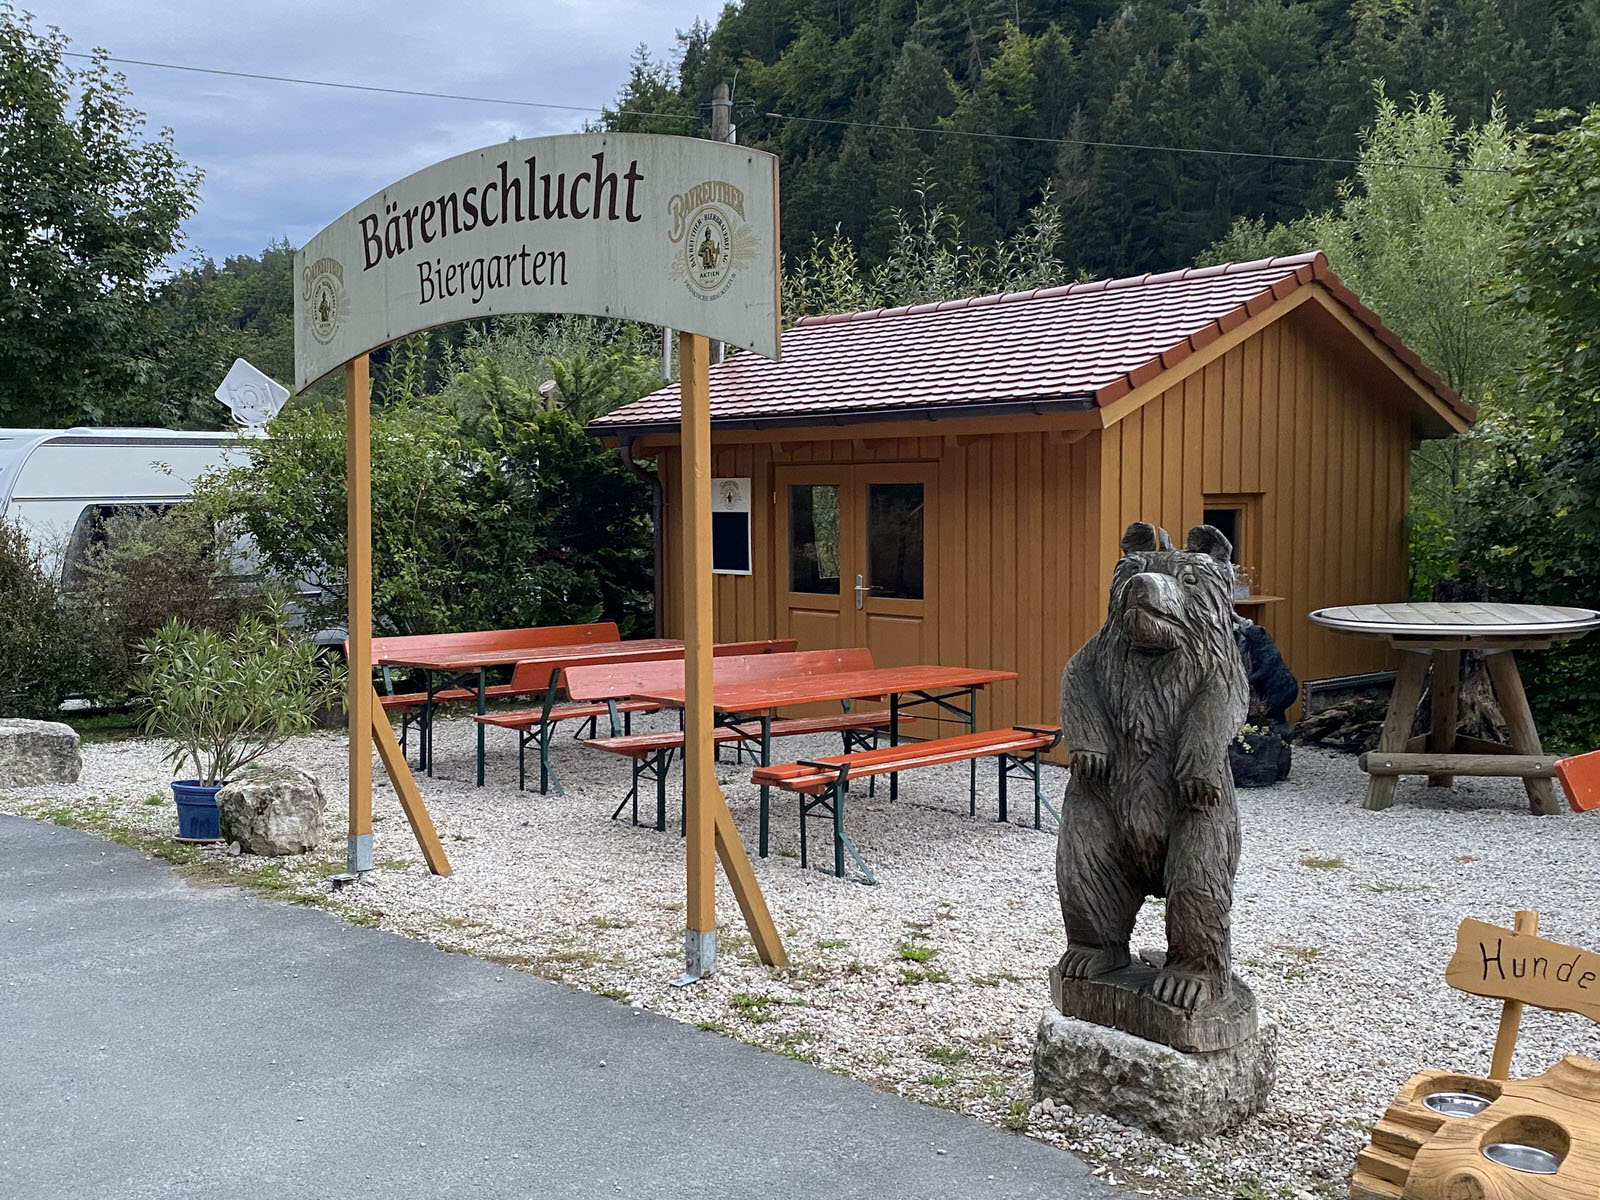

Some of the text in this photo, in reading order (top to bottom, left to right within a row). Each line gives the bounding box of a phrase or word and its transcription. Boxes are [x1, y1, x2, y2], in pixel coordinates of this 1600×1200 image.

[359, 152, 644, 272] Bärenschlucht
[667, 180, 745, 243] BAYREUTHER
[417, 244, 568, 305] Biergarten
[1480, 938, 1596, 989] Hunde
